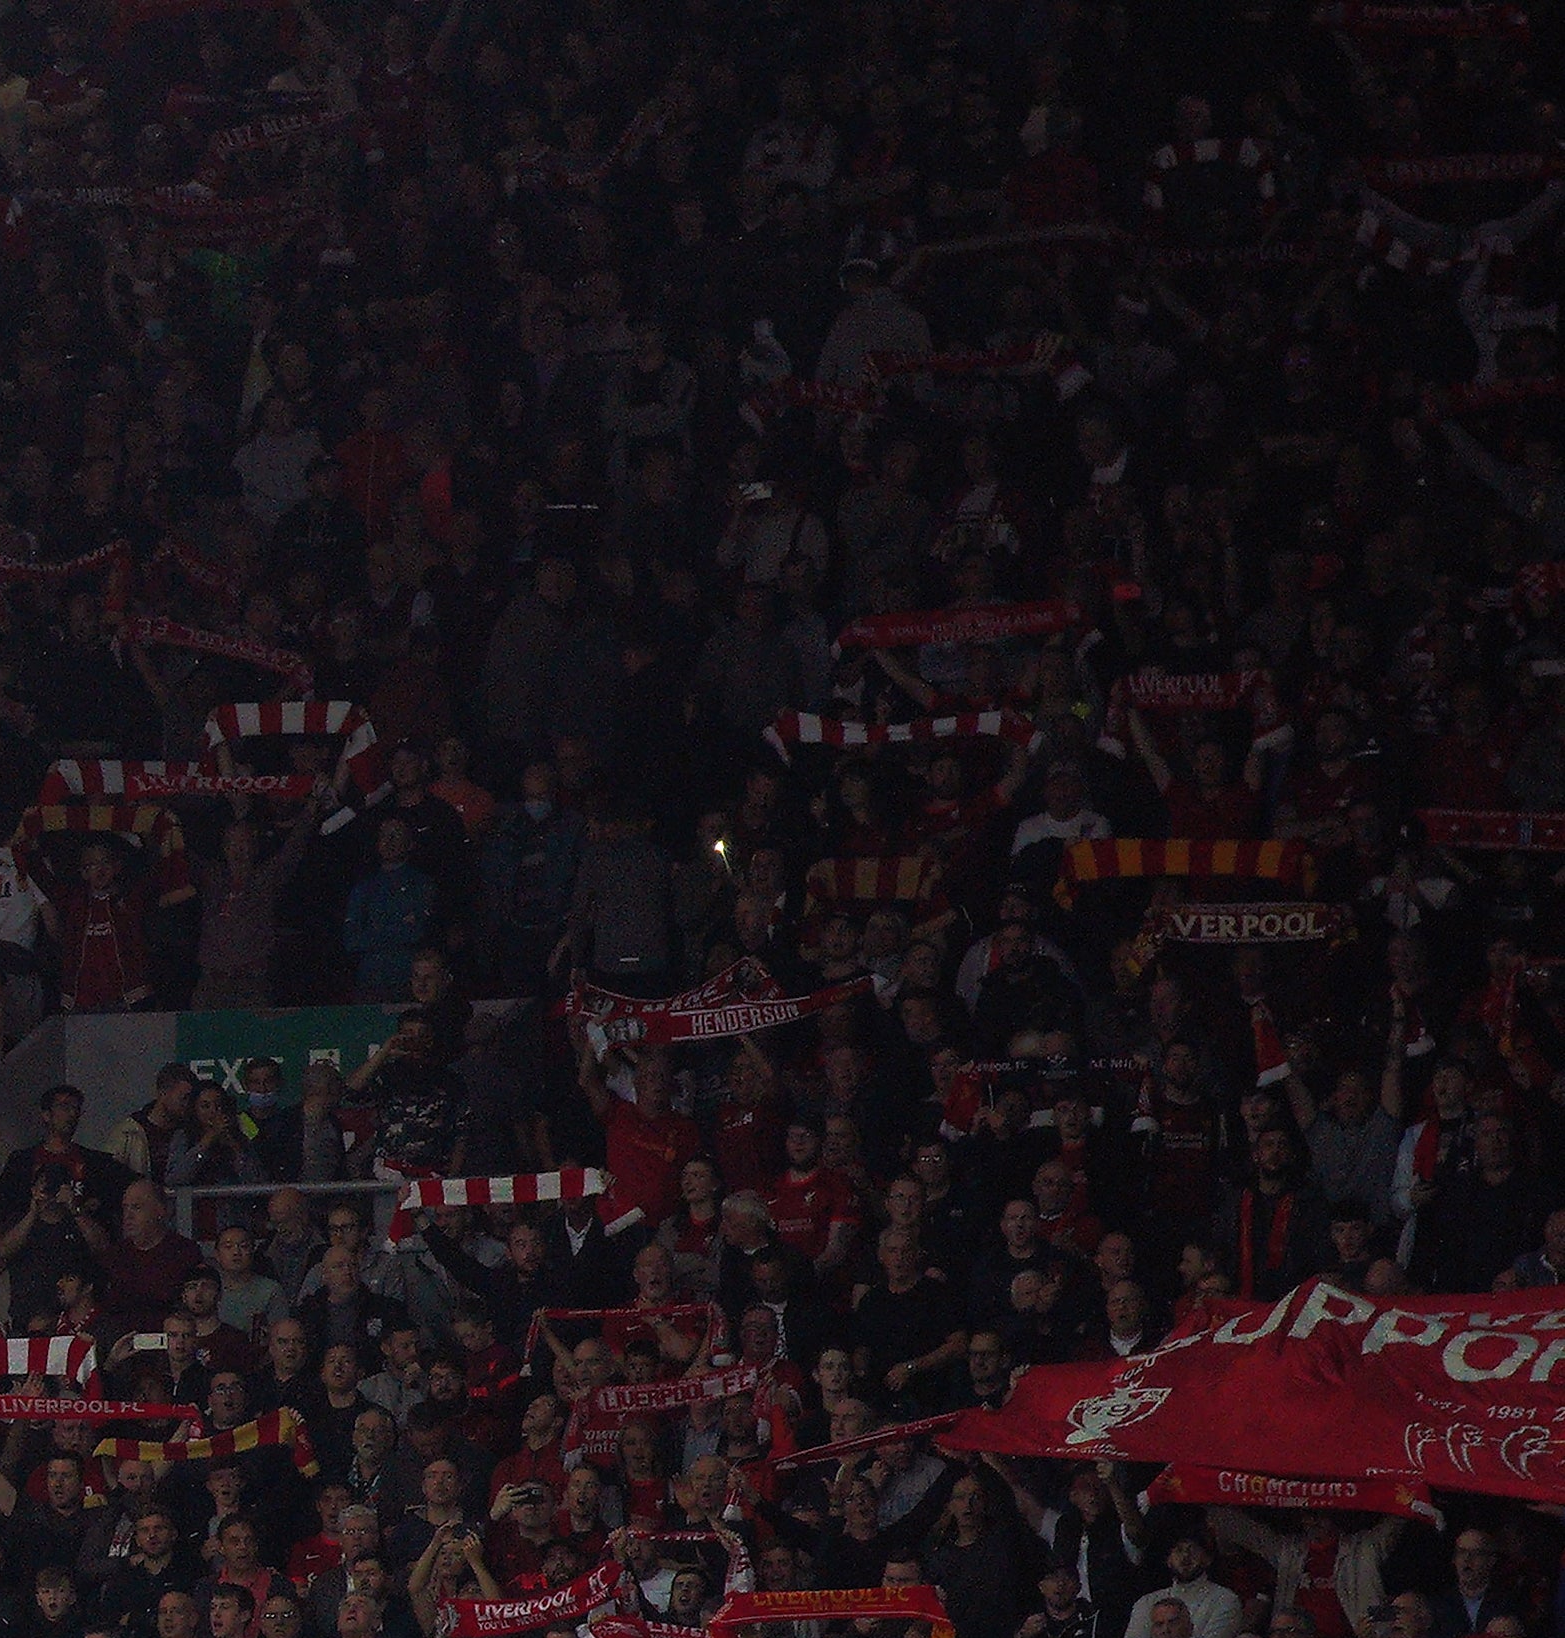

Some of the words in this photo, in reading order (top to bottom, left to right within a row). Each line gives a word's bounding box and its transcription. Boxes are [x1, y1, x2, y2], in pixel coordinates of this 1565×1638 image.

[691, 1003, 800, 1034] HENDERSON
[190, 1057, 284, 1095] EX
[1, 1398, 118, 1415] LIVERPOOL
[603, 1380, 707, 1412] LIVERPOOL
[1486, 1405, 1539, 1421] 1981
[473, 1588, 576, 1621] LIVERPOOL
